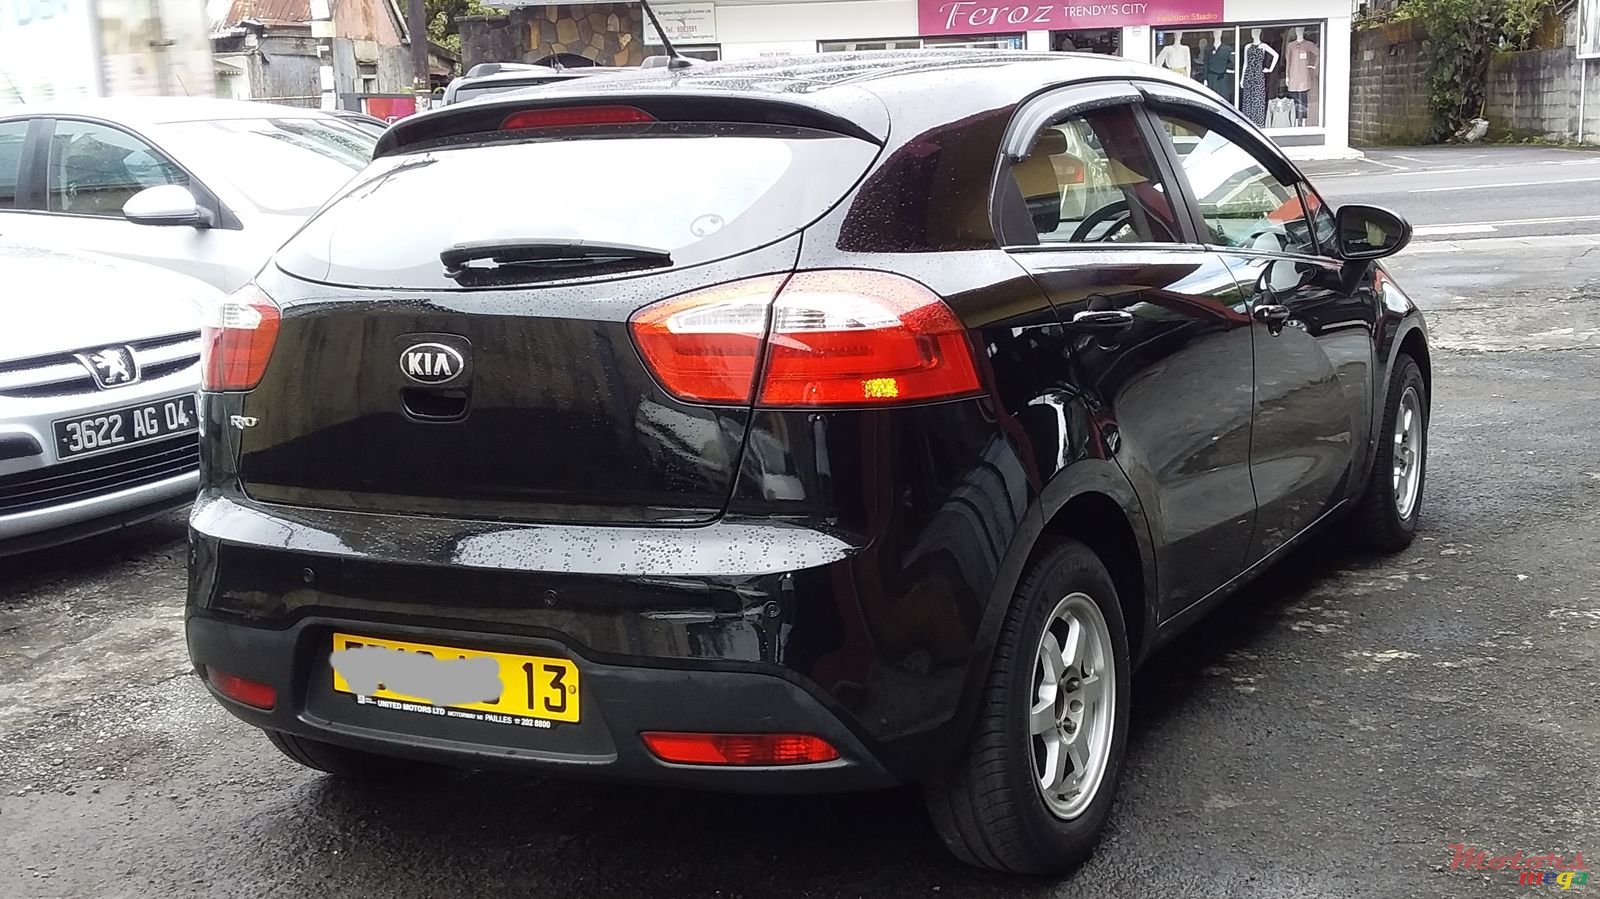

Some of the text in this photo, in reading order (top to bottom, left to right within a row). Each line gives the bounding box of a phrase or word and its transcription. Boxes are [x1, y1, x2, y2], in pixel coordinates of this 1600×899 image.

[940, 1, 1054, 30] Feroz
[1063, 3, 1148, 17] TRENDY'S CITY
[1191, 12, 1218, 20] Studio
[408, 352, 452, 376] KIA
[66, 400, 190, 452] 3622 AG 04
[521, 662, 567, 713] 13
[377, 699, 402, 710] UNITED
[402, 703, 432, 714] MOTORS
[432, 706, 445, 716] LTD
[485, 713, 513, 724] PAILLES
